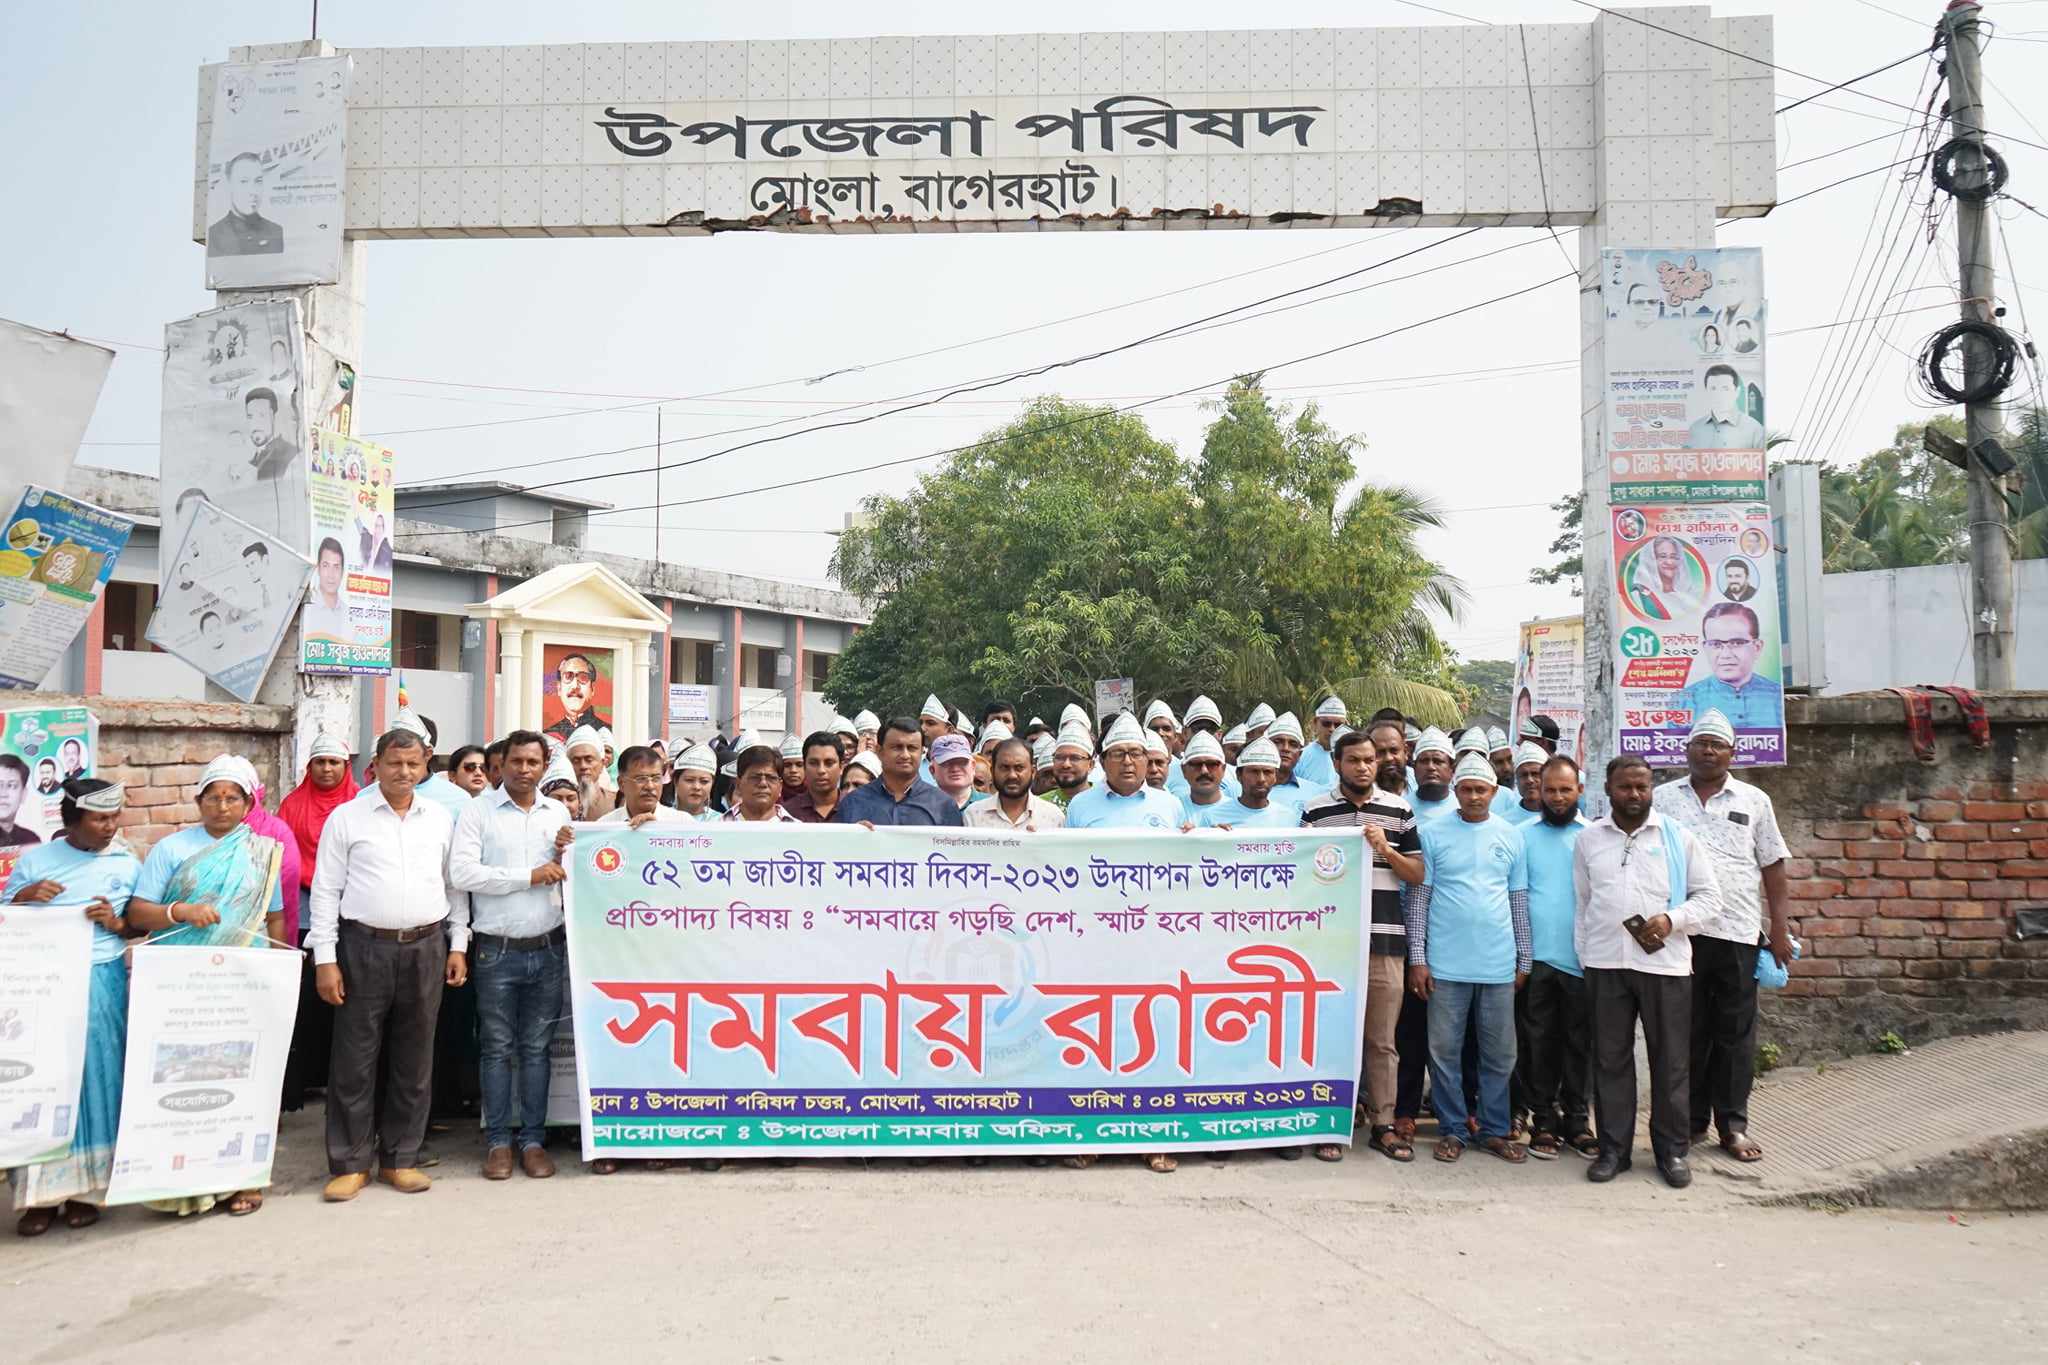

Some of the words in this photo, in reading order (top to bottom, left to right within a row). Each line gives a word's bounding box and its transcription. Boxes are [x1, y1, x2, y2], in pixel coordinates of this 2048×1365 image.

[594, 107, 994, 159] উপজেলা
[1015, 96, 1326, 152] পরিষদ
[749, 171, 893, 221] মোংলা,
[1664, 648, 1699, 656] ২০২৩
[1625, 710, 1692, 727] শুভেচ্ছা
[1622, 734, 1651, 751] মোঃ
[649, 837, 685, 849] সমবায়
[1237, 842, 1270, 854] সমবায়
[642, 859, 681, 888] ৫২
[690, 860, 735, 886] তম
[743, 850, 826, 887] জাতীয়
[834, 859, 918, 888] সমবায়
[925, 852, 1080, 893] দিবস-২০২৩
[1200, 855, 1297, 890] উপলক্ষে
[606, 900, 719, 930] প্রতিপাদ্য
[728, 901, 792, 930] বিষয়
[950, 904, 1016, 936] গড়ছি
[1025, 909, 1084, 938] দেশ,
[1094, 904, 1150, 933] স্মার্ট
[1155, 911, 1204, 935] হবে
[592, 968, 1007, 1077] সমবায়
[645, 1091, 728, 1110] উপজেলা
[735, 1091, 799, 1111] পরিষদ
[860, 1094, 926, 1113] মোংলা,
[1068, 1090, 1126, 1109] তারিখ
[1149, 1093, 1176, 1107] ০৪
[1183, 1091, 1247, 1109] নভেম্বর
[1253, 1087, 1305, 1105] ২০২৩
[759, 1120, 880, 1140] উপজেলা
[888, 1122, 983, 1140] সমবায়
[990, 1119, 1083, 1141] অফিস,
[1096, 1118, 1190, 1140] মোংলা,
